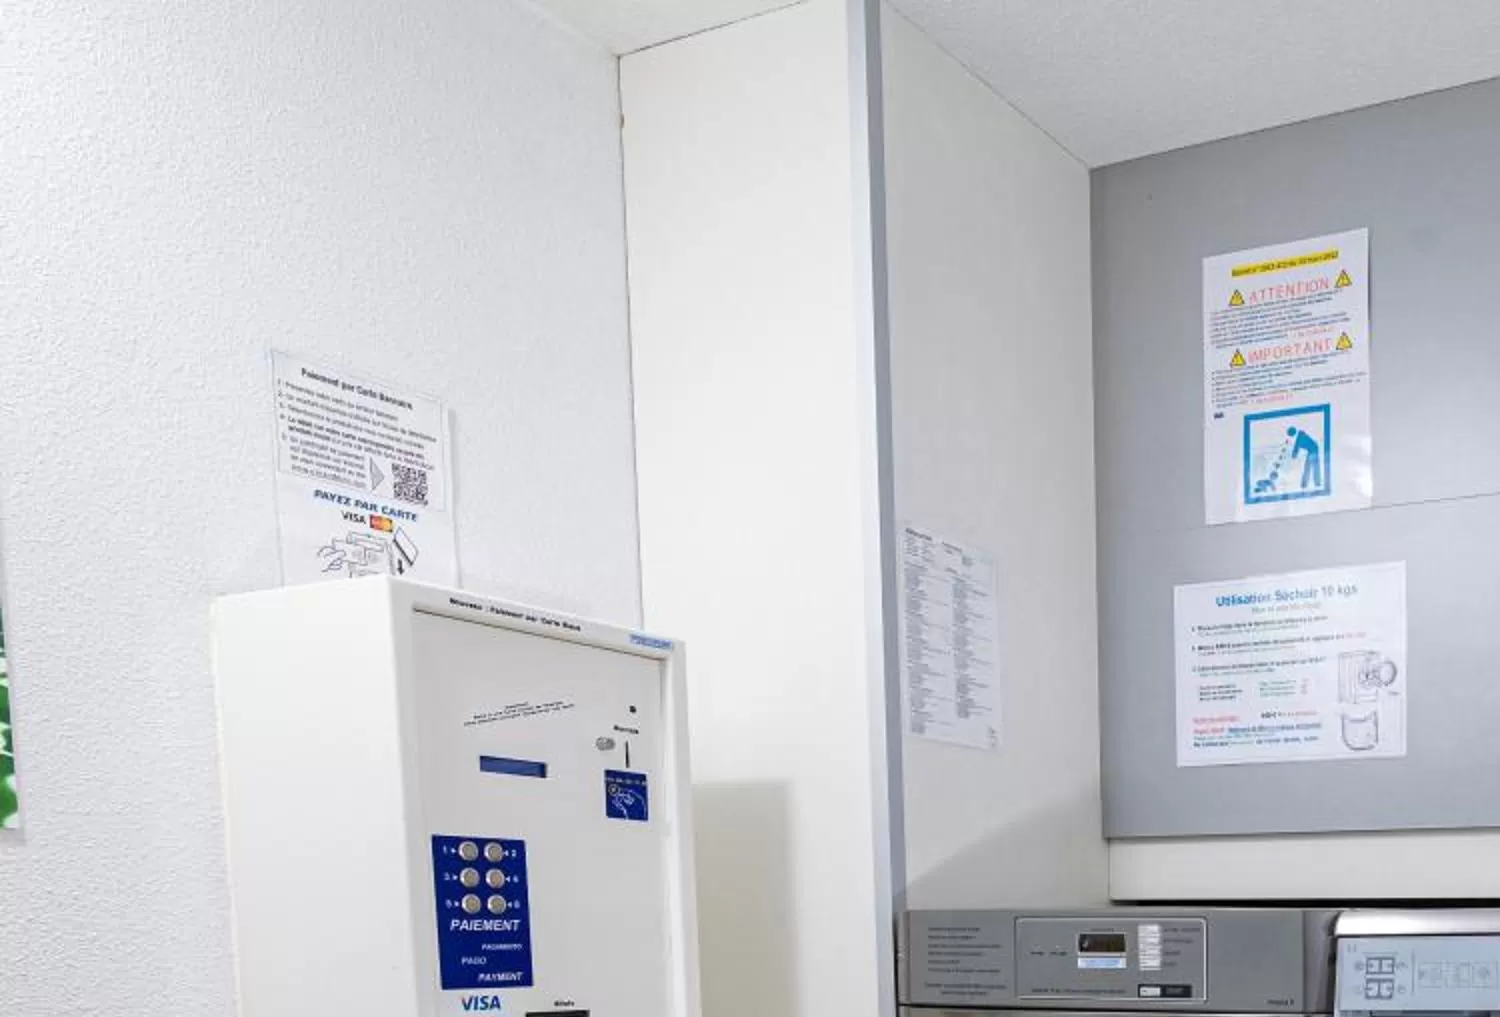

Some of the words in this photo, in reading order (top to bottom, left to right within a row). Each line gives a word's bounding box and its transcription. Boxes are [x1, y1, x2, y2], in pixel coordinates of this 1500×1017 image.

[1249, 277, 1330, 304] ATTENTION
[1248, 338, 1332, 364] IMPORTANT
[313, 489, 352, 507] PAYEZ
[354, 499, 379, 513] PAR
[381, 505, 418, 522] CARTE
[340, 510, 367, 525] VISA
[450, 918, 521, 932] PAIEMENT
[477, 972, 523, 982] PAYMENT
[461, 995, 502, 1012] VISA
